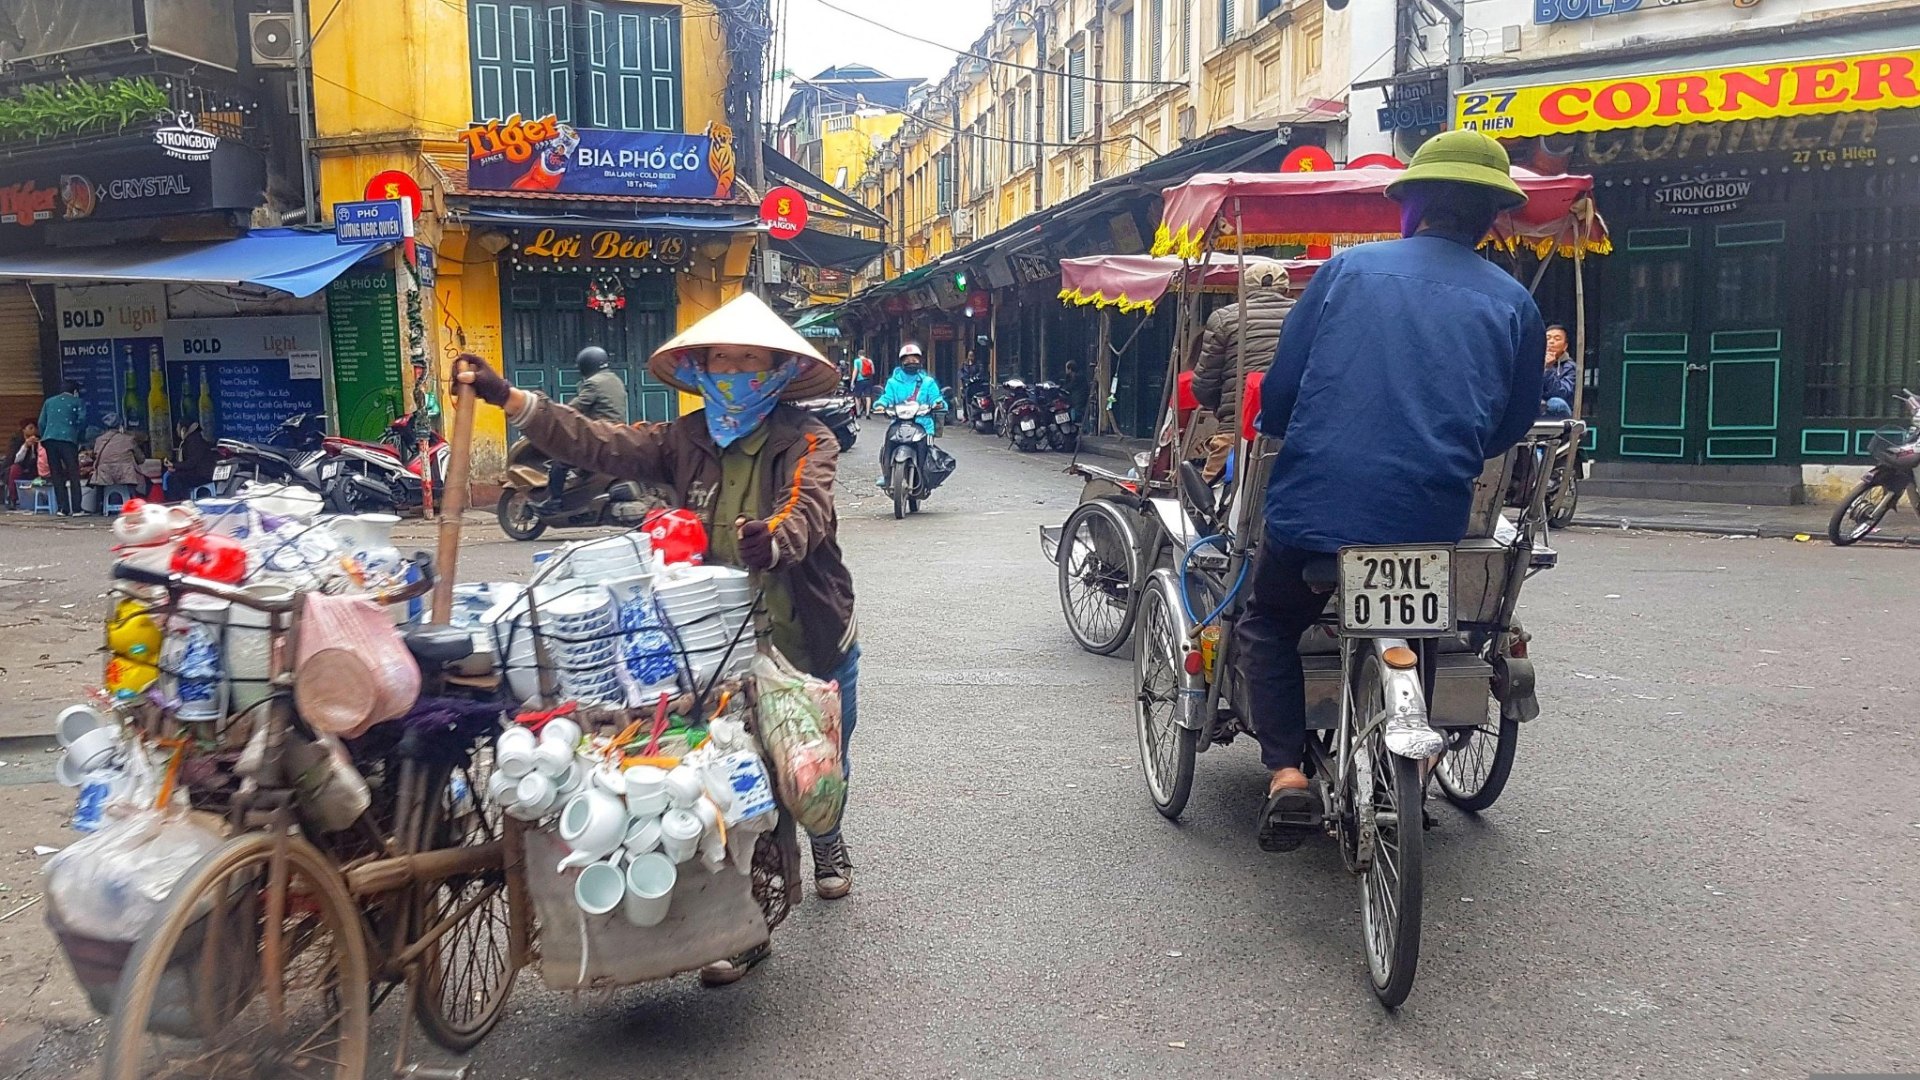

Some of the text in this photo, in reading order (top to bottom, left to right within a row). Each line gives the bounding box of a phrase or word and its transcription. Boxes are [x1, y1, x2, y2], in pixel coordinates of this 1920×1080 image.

[1538, 57, 1920, 126] CORNER
[1463, 92, 1517, 116] 27
[1482, 116, 1514, 132] HIỆN
[156, 131, 218, 150] STRONGBOW
[458, 113, 560, 163] Tiger
[166, 150, 210, 161] APPLE CIDERS
[481, 153, 503, 163] SINCE
[578, 149, 615, 167] BIA
[1792, 151, 1810, 163] 27
[109, 175, 190, 200] CRYSTAL
[1655, 181, 1751, 203] STRONGBOW
[357, 205, 379, 218] PHỐ
[1670, 202, 1737, 215] APPLE CIDERS
[524, 228, 682, 263] Lợi Béo 18
[63, 305, 157, 331] BOLD Light
[183, 336, 297, 356] BOLD Light
[1363, 558, 1431, 590] 29XL
[1354, 592, 1439, 625] 0160
